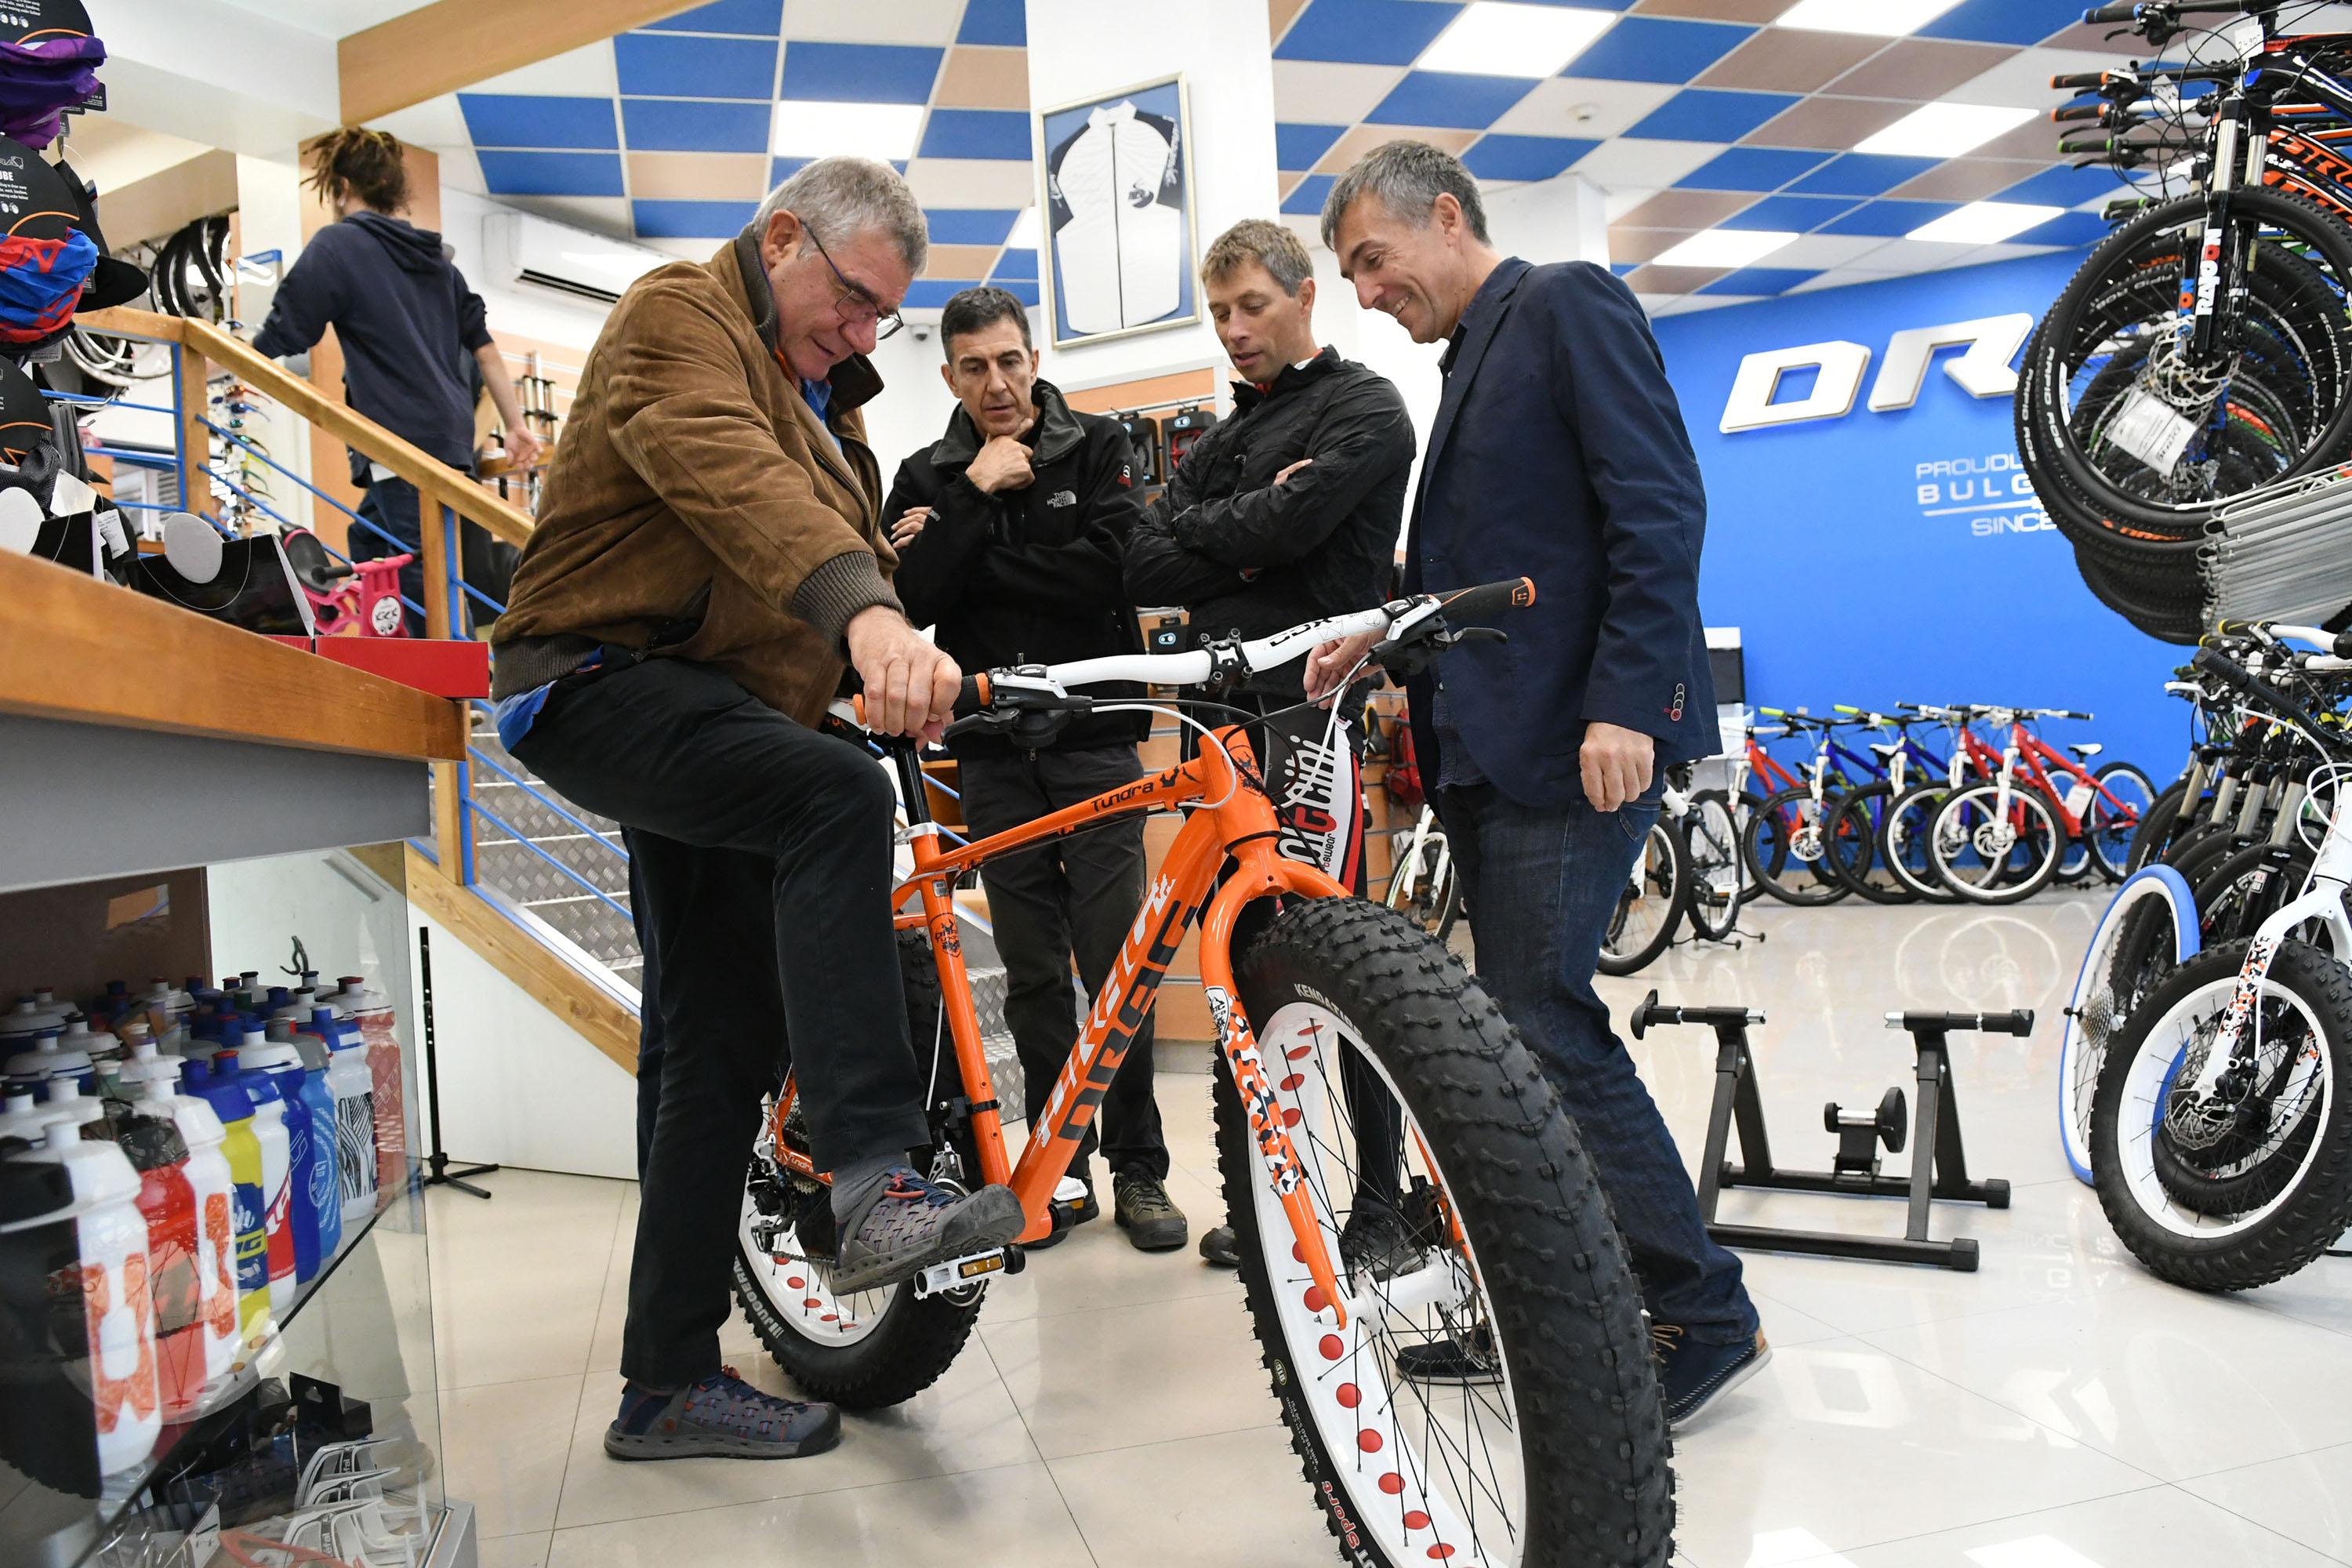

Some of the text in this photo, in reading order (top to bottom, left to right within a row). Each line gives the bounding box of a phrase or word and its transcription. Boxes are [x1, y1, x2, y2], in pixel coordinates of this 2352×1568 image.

[1047, 497, 1067, 506] NORTH
[1971, 511, 2057, 536] SINCE
[1091, 782, 1155, 812] Tundra
[1058, 900, 1196, 1140] DRAG
